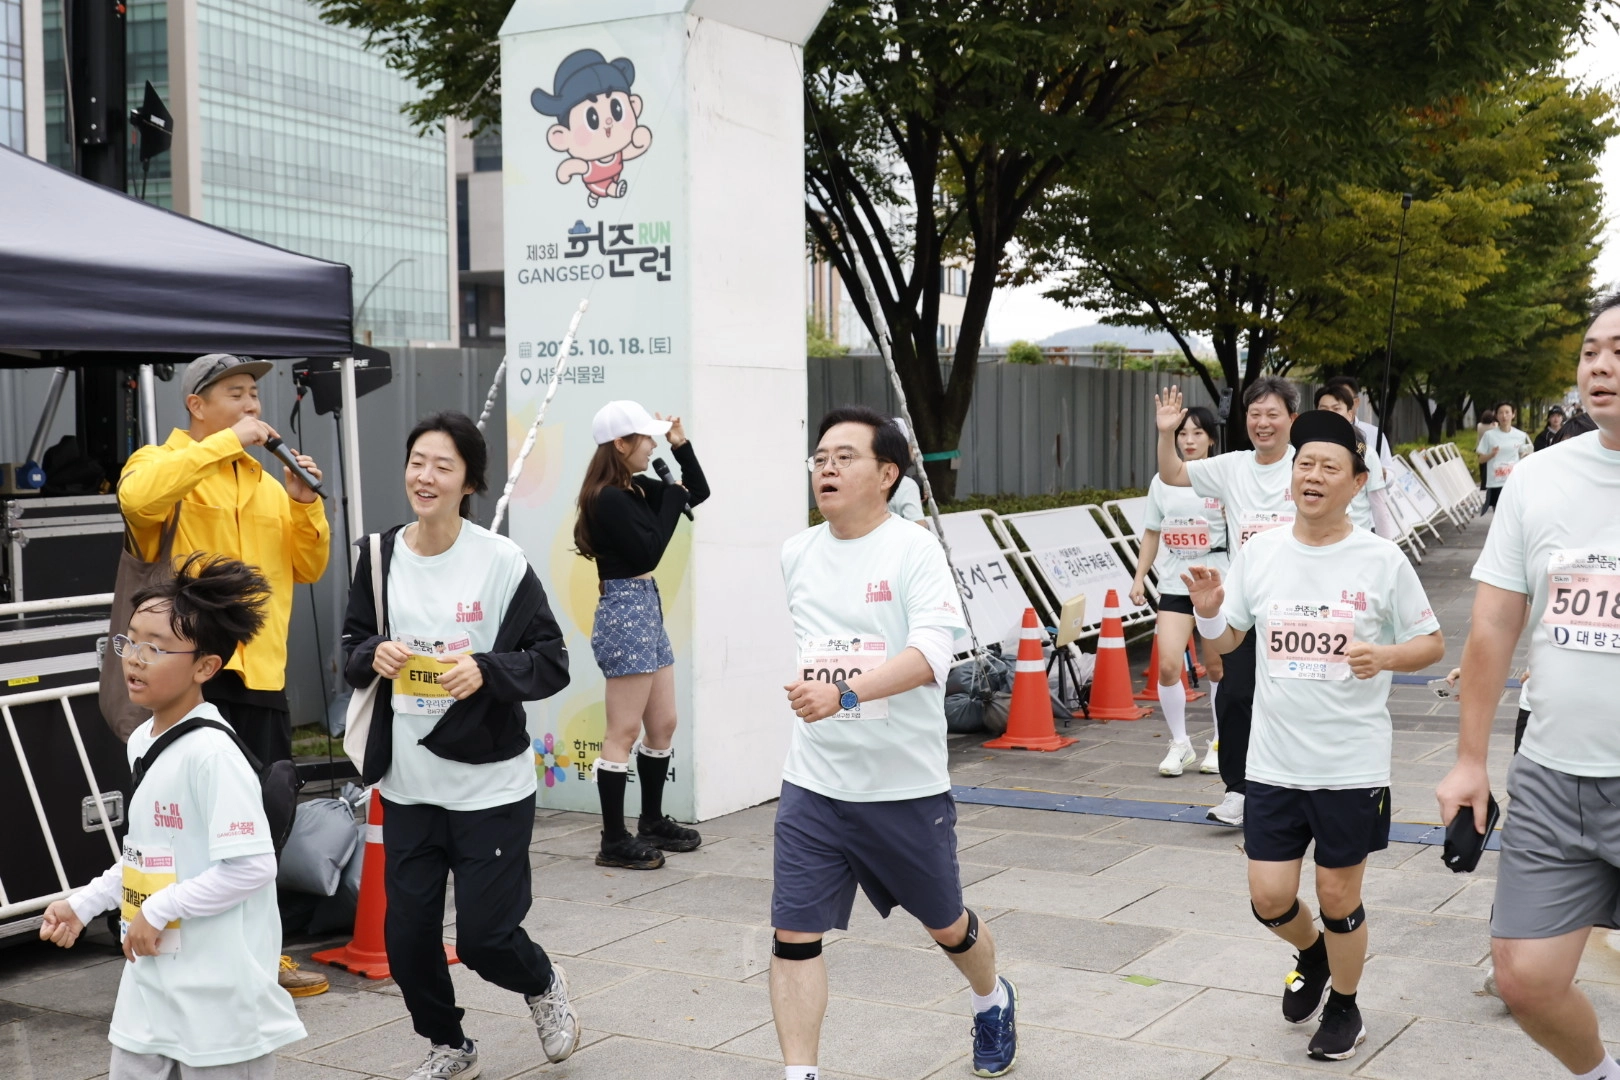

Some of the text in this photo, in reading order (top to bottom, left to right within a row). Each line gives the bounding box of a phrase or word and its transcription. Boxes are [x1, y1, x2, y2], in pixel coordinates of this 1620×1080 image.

[638, 221, 671, 245] RUN
[526, 243, 559, 261] 제3회
[518, 264, 605, 284] GANGSEO
[537, 336, 672, 358] 205. 10. 18. [토]
[332, 359, 369, 369] SRE
[1164, 533, 1207, 546] 55516
[1270, 631, 1347, 656] 50032
[574, 739, 602, 758] 함께
